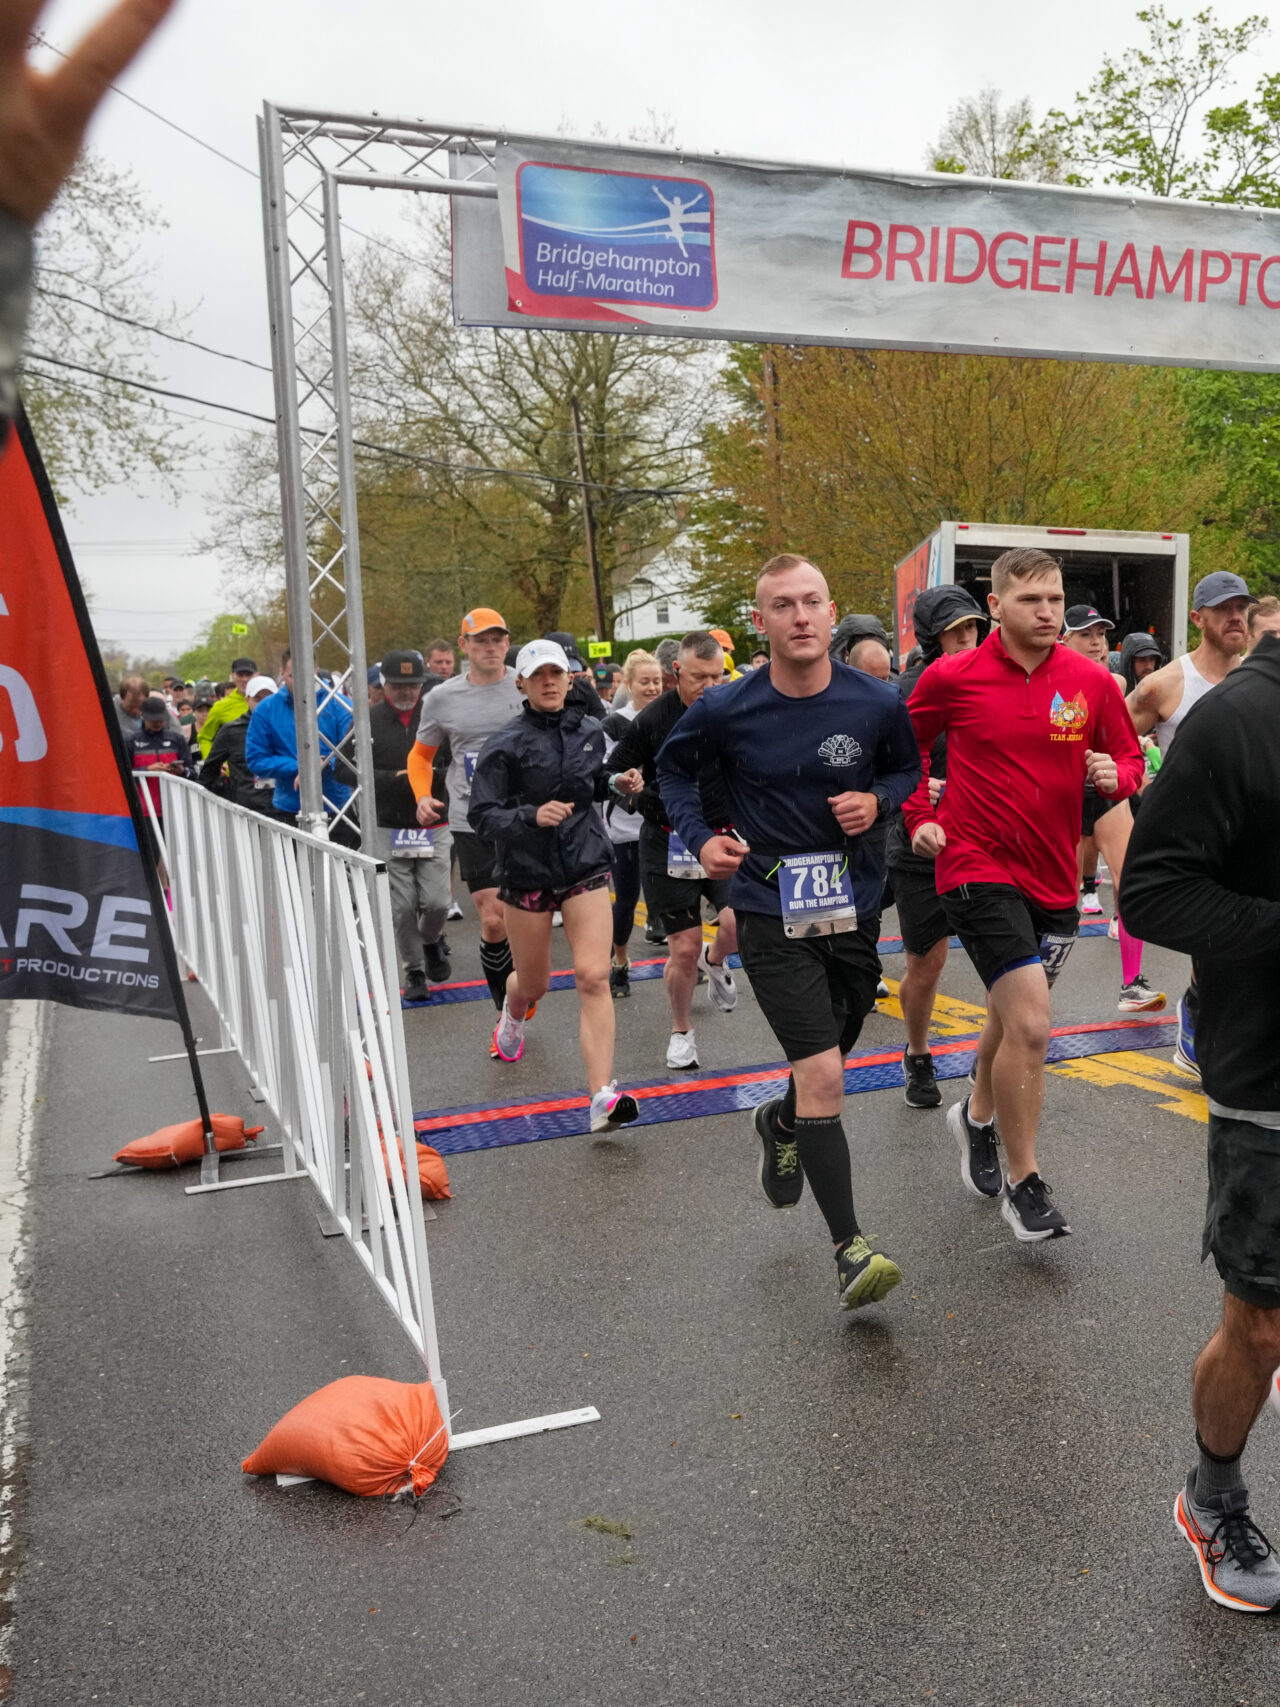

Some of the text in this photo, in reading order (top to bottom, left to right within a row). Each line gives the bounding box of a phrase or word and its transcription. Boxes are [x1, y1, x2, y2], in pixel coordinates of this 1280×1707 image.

[536, 242, 700, 278] Bridgehampton
[538, 269, 675, 297] Half-Marathon
[1050, 733, 1066, 741] TEAM
[791, 864, 843, 899] 784
[789, 895, 849, 910] RUN THE HAMPTONS
[0, 884, 152, 963] RE
[17, 958, 159, 989] PRODUCTIONS
